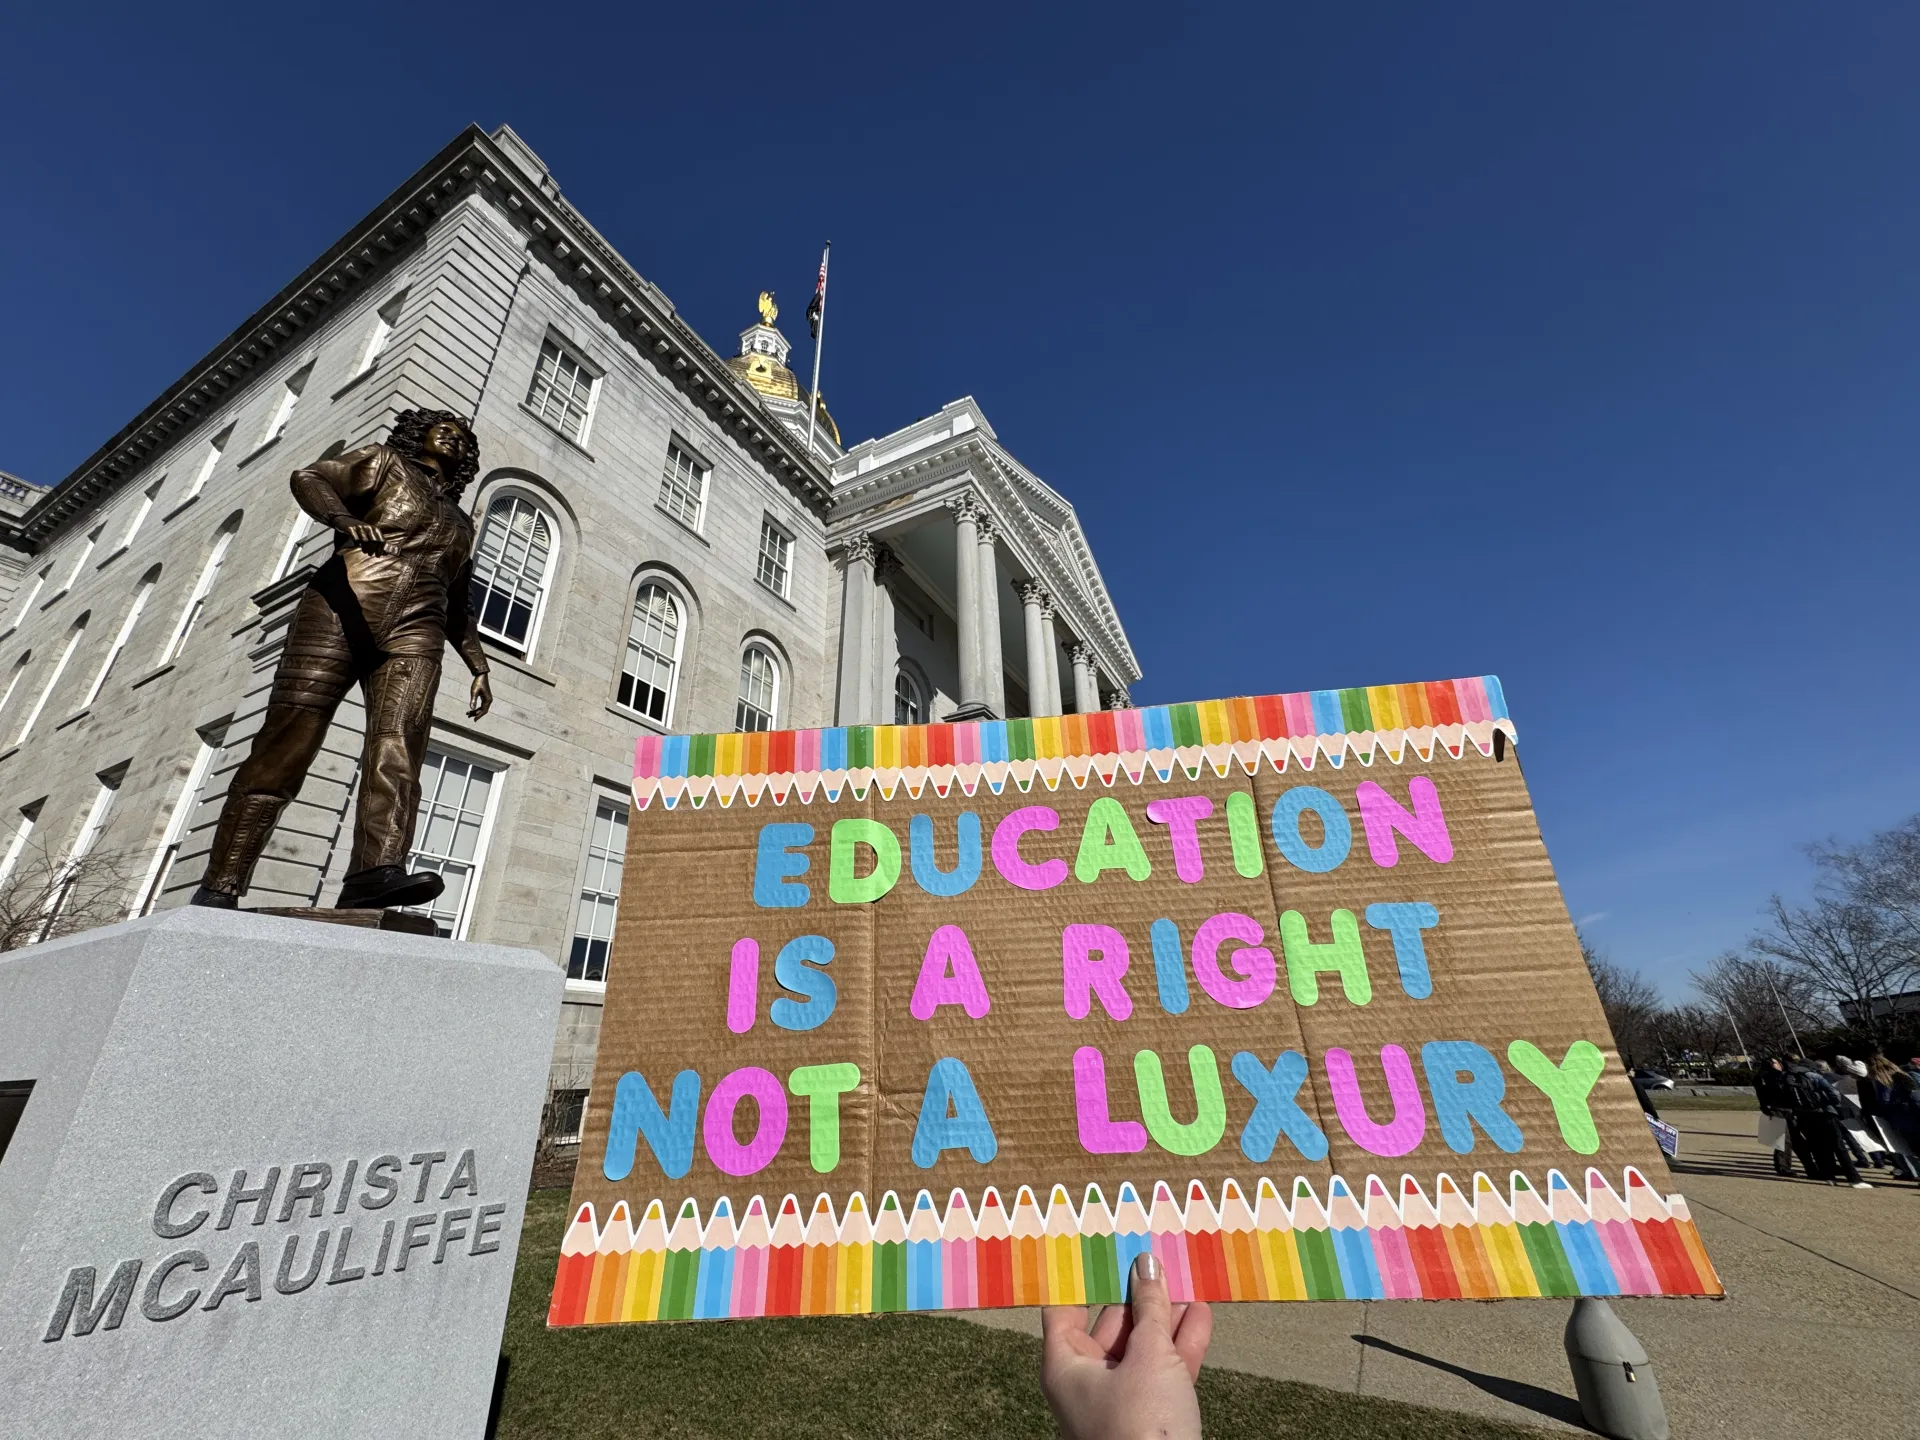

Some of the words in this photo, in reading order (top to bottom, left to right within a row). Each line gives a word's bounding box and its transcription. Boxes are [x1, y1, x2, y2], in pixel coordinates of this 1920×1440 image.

[753, 775, 1454, 908] EDUCATION
[726, 935, 837, 1034] IS
[910, 924, 991, 1021] A
[1062, 902, 1440, 1021] RIGHT
[603, 1062, 861, 1181] NOT
[911, 1057, 998, 1168] A
[1073, 1039, 1606, 1163] LUXURY
[151, 1149, 478, 1239] CHRISTA
[42, 1203, 505, 1342] MCAULIFFE
